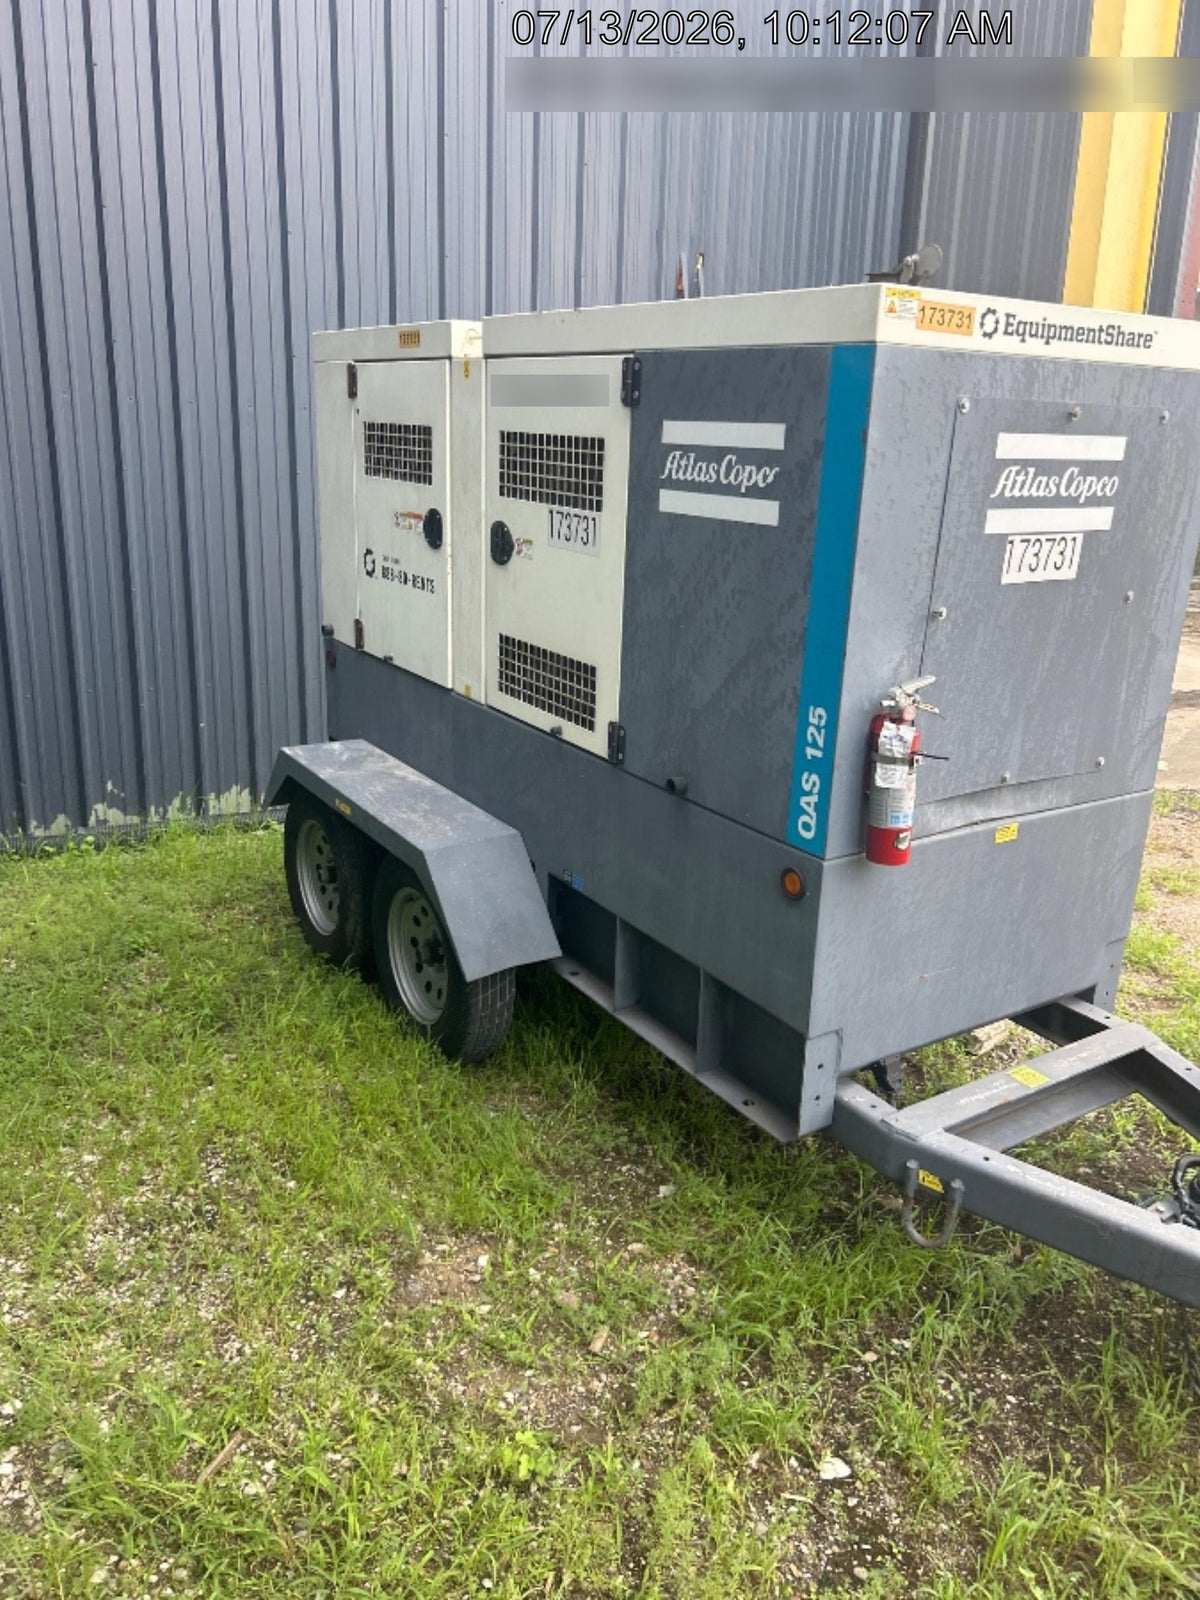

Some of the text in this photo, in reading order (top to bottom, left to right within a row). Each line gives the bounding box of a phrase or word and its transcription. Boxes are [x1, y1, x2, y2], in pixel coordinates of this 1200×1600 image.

[918, 305, 974, 331] 173731
[1003, 313, 1153, 349] EquipmentShare
[660, 450, 718, 482] Atlas
[990, 465, 1120, 503] Atlas Copco
[549, 509, 596, 547] 173731
[1006, 536, 1077, 574] 173731
[797, 705, 827, 840] QAS 125
